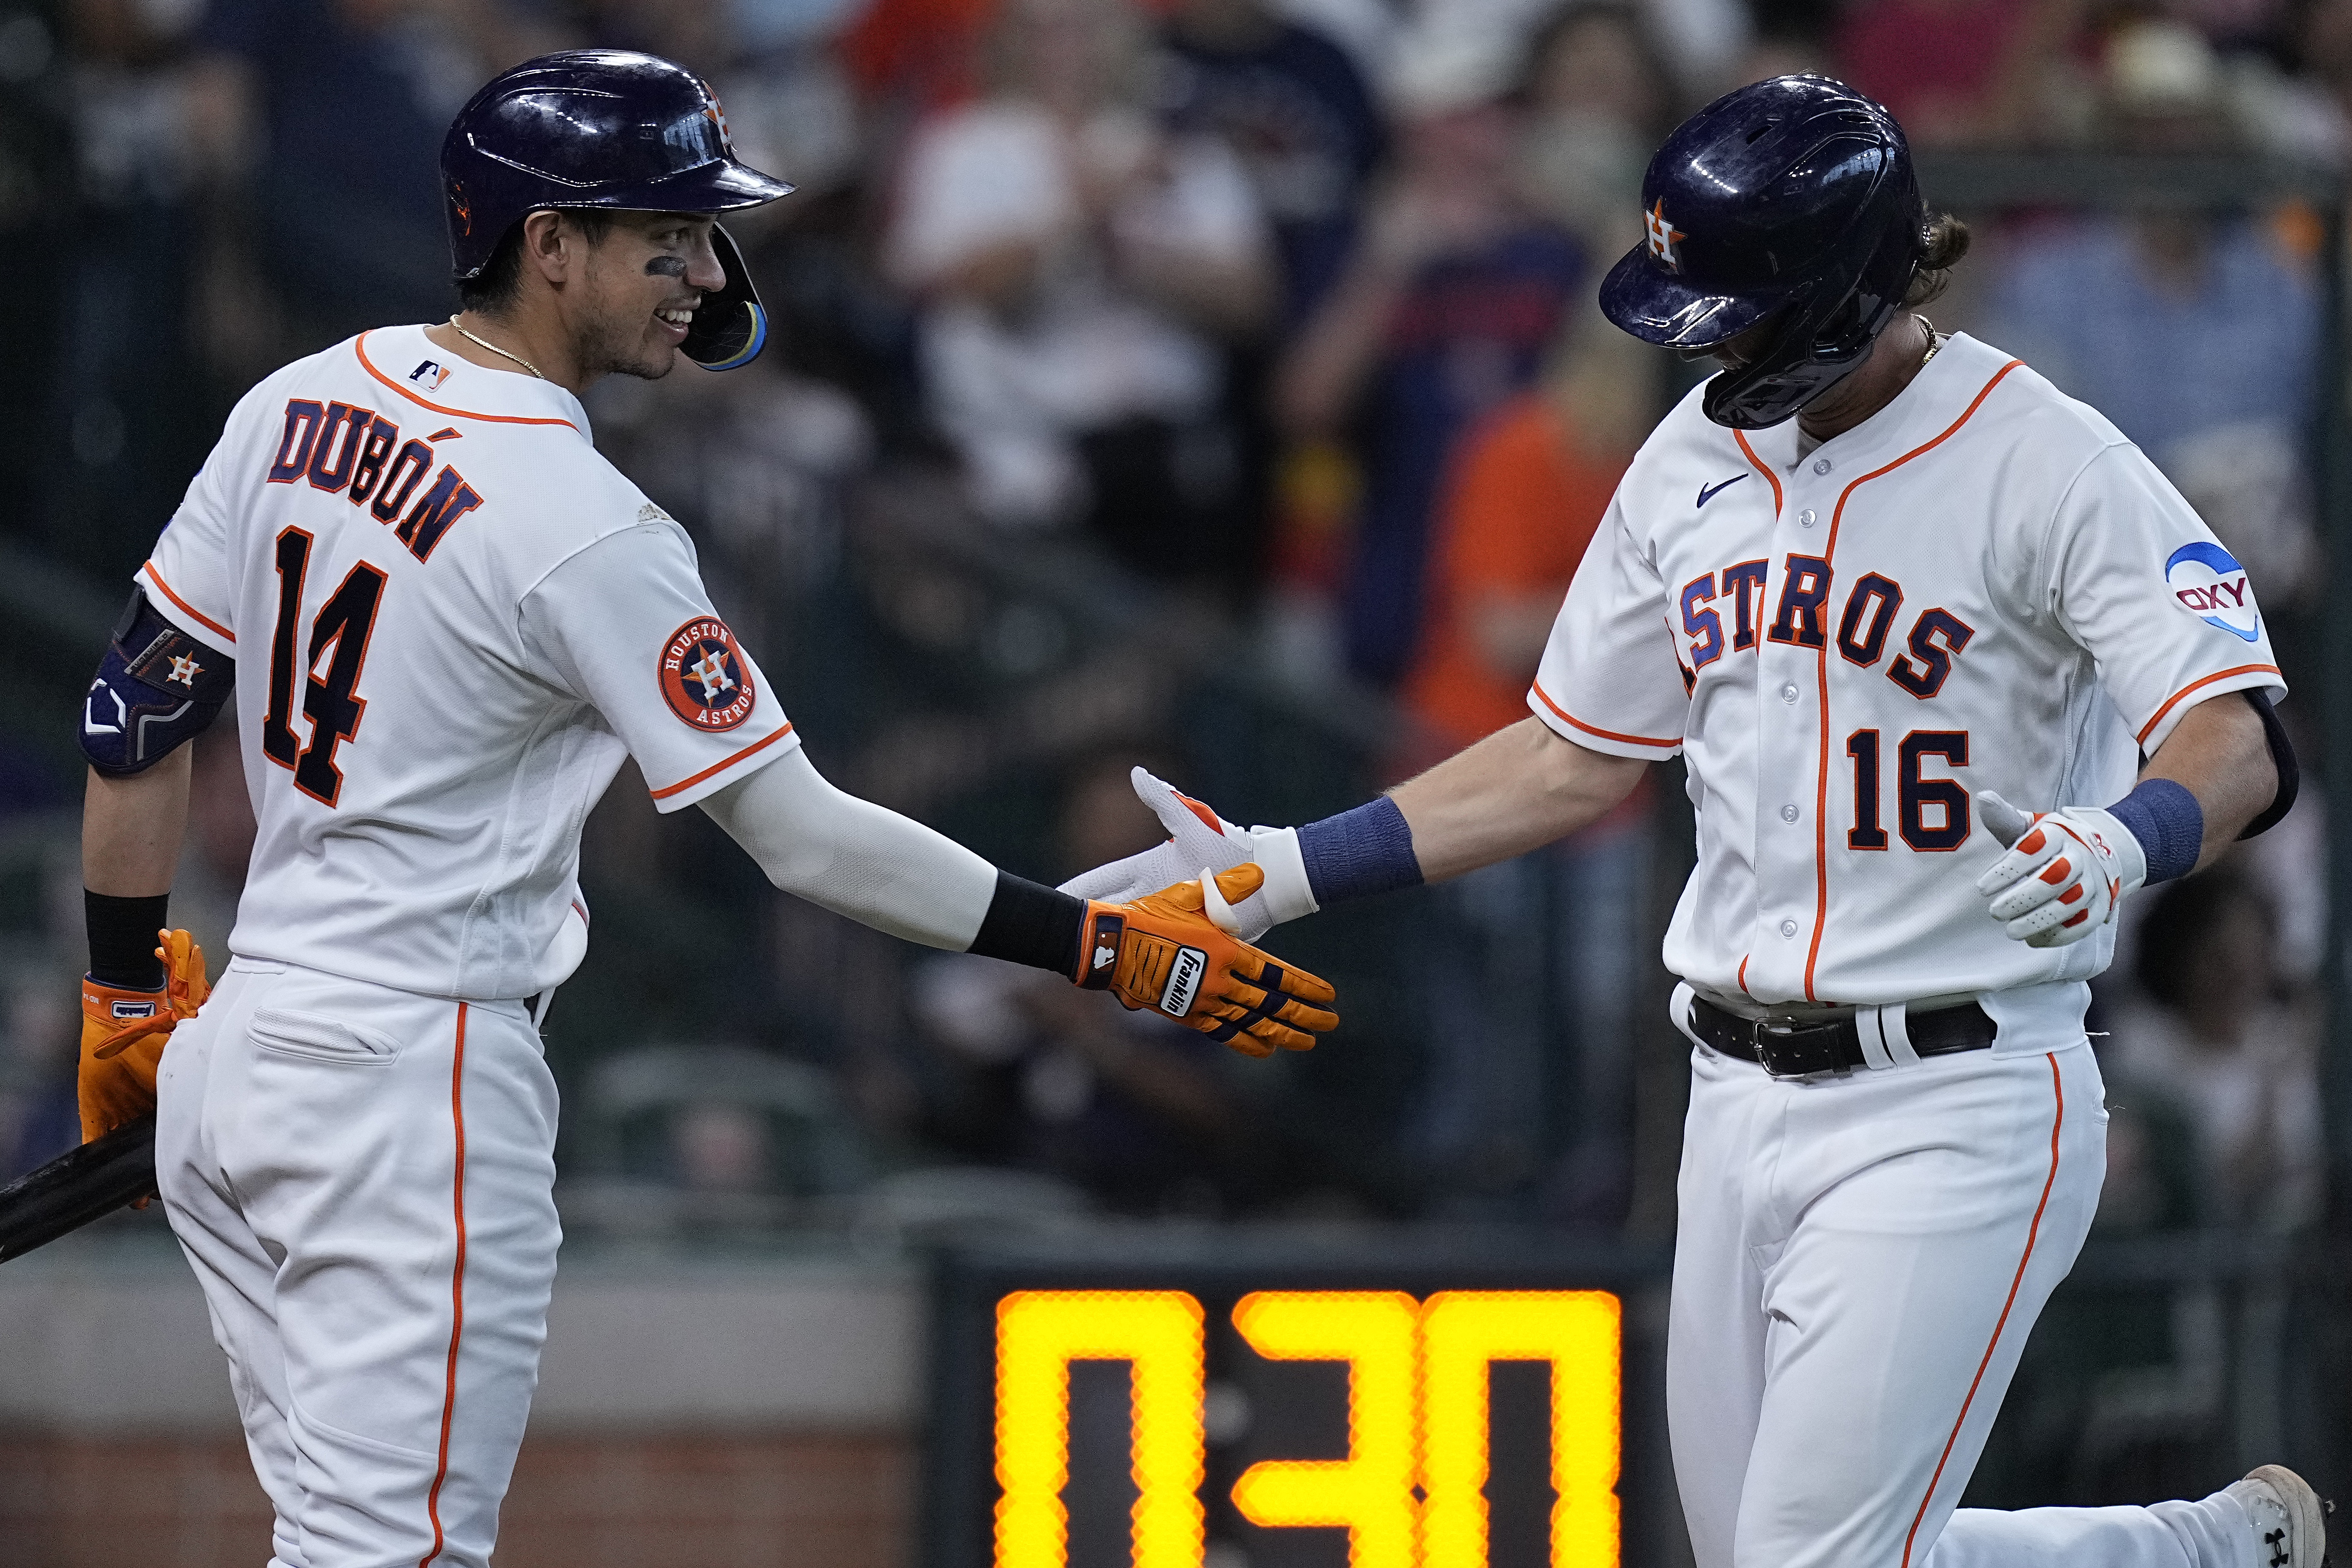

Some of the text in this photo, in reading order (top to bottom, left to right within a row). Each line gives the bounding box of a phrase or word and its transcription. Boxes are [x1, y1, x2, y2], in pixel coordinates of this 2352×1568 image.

[267, 399, 484, 564] DUBÓN
[666, 624, 729, 671] HOUSTON
[1665, 553, 1975, 700] STROS
[2176, 577, 2246, 610] OXY
[263, 525, 389, 808] 14
[696, 684, 752, 724] ASTROS
[1847, 729, 1970, 852] 16
